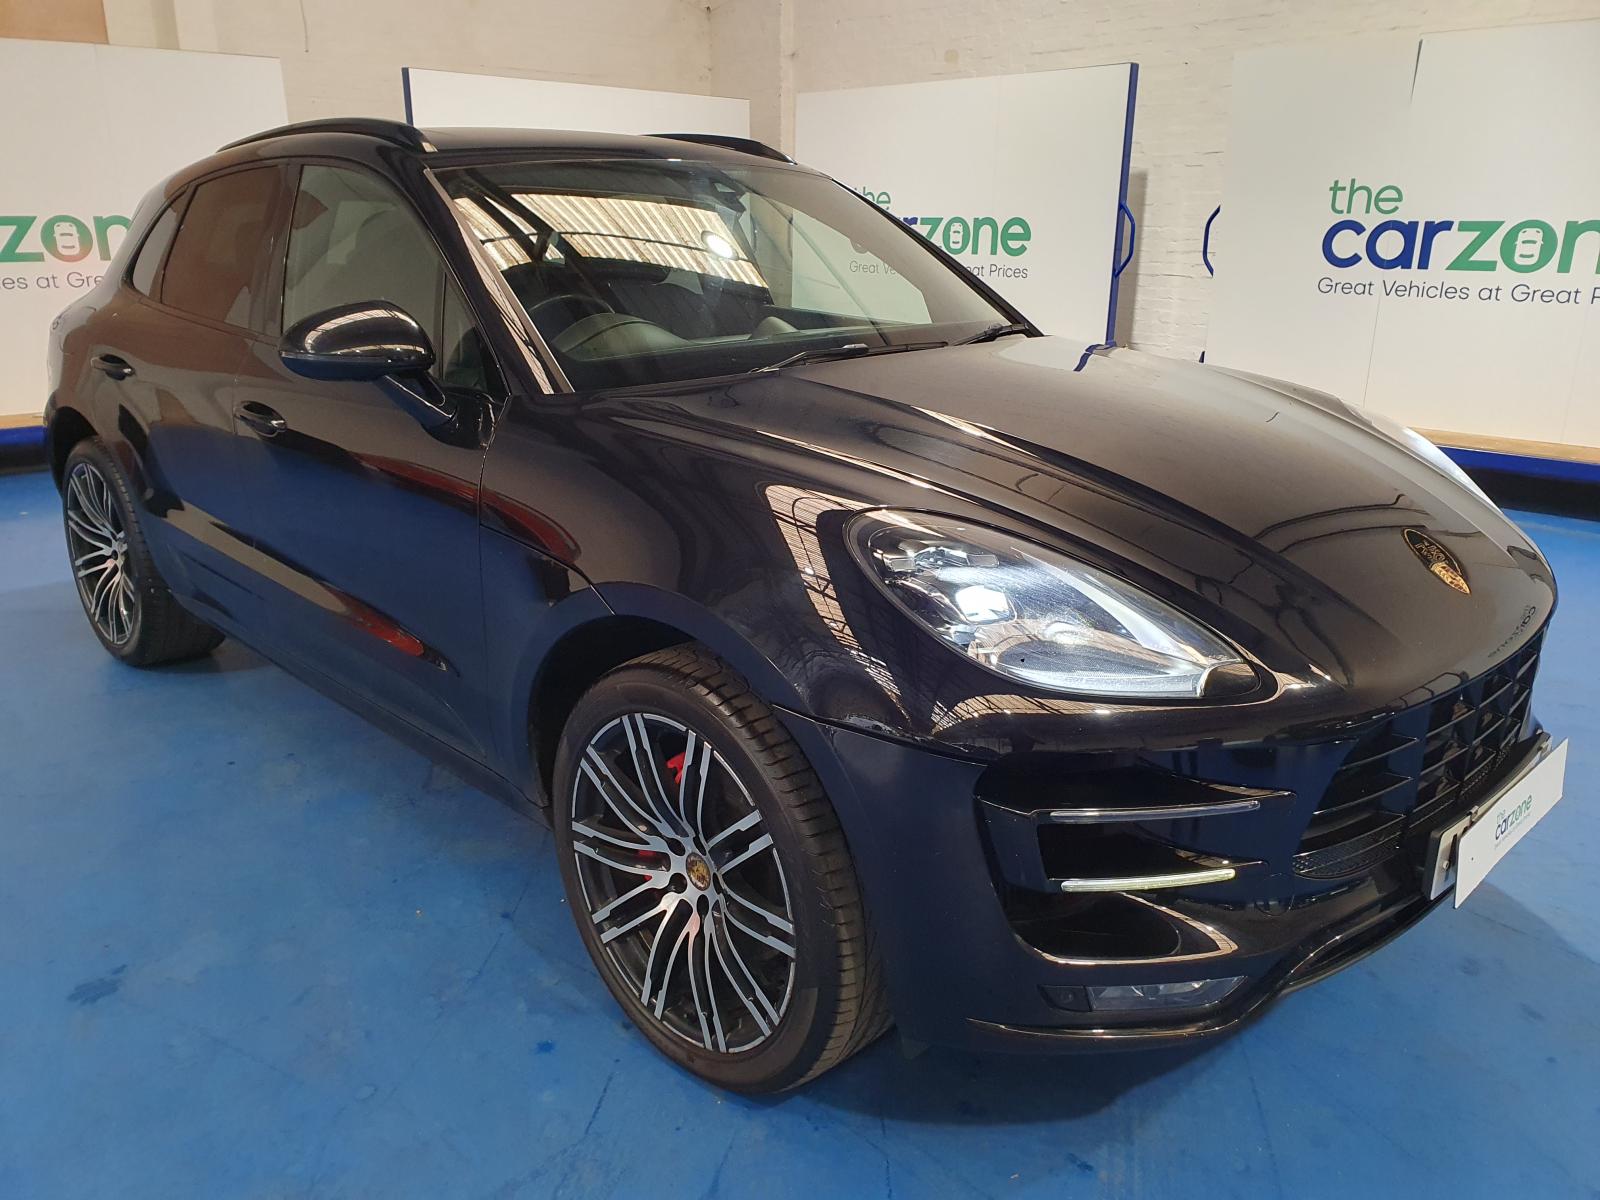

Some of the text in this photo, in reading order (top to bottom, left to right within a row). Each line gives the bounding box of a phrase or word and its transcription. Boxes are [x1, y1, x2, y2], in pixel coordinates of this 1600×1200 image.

[854, 186, 891, 210] he
[1329, 178, 1403, 214] the
[36, 274, 60, 289] at
[849, 260, 880, 274] Great
[989, 263, 1029, 279] Prices
[1317, 276, 1375, 296] Great
[1382, 279, 1470, 301] Vehicles
[1478, 284, 1502, 302] at
[1511, 283, 1582, 305] Great
[1494, 794, 1533, 841] carzone
